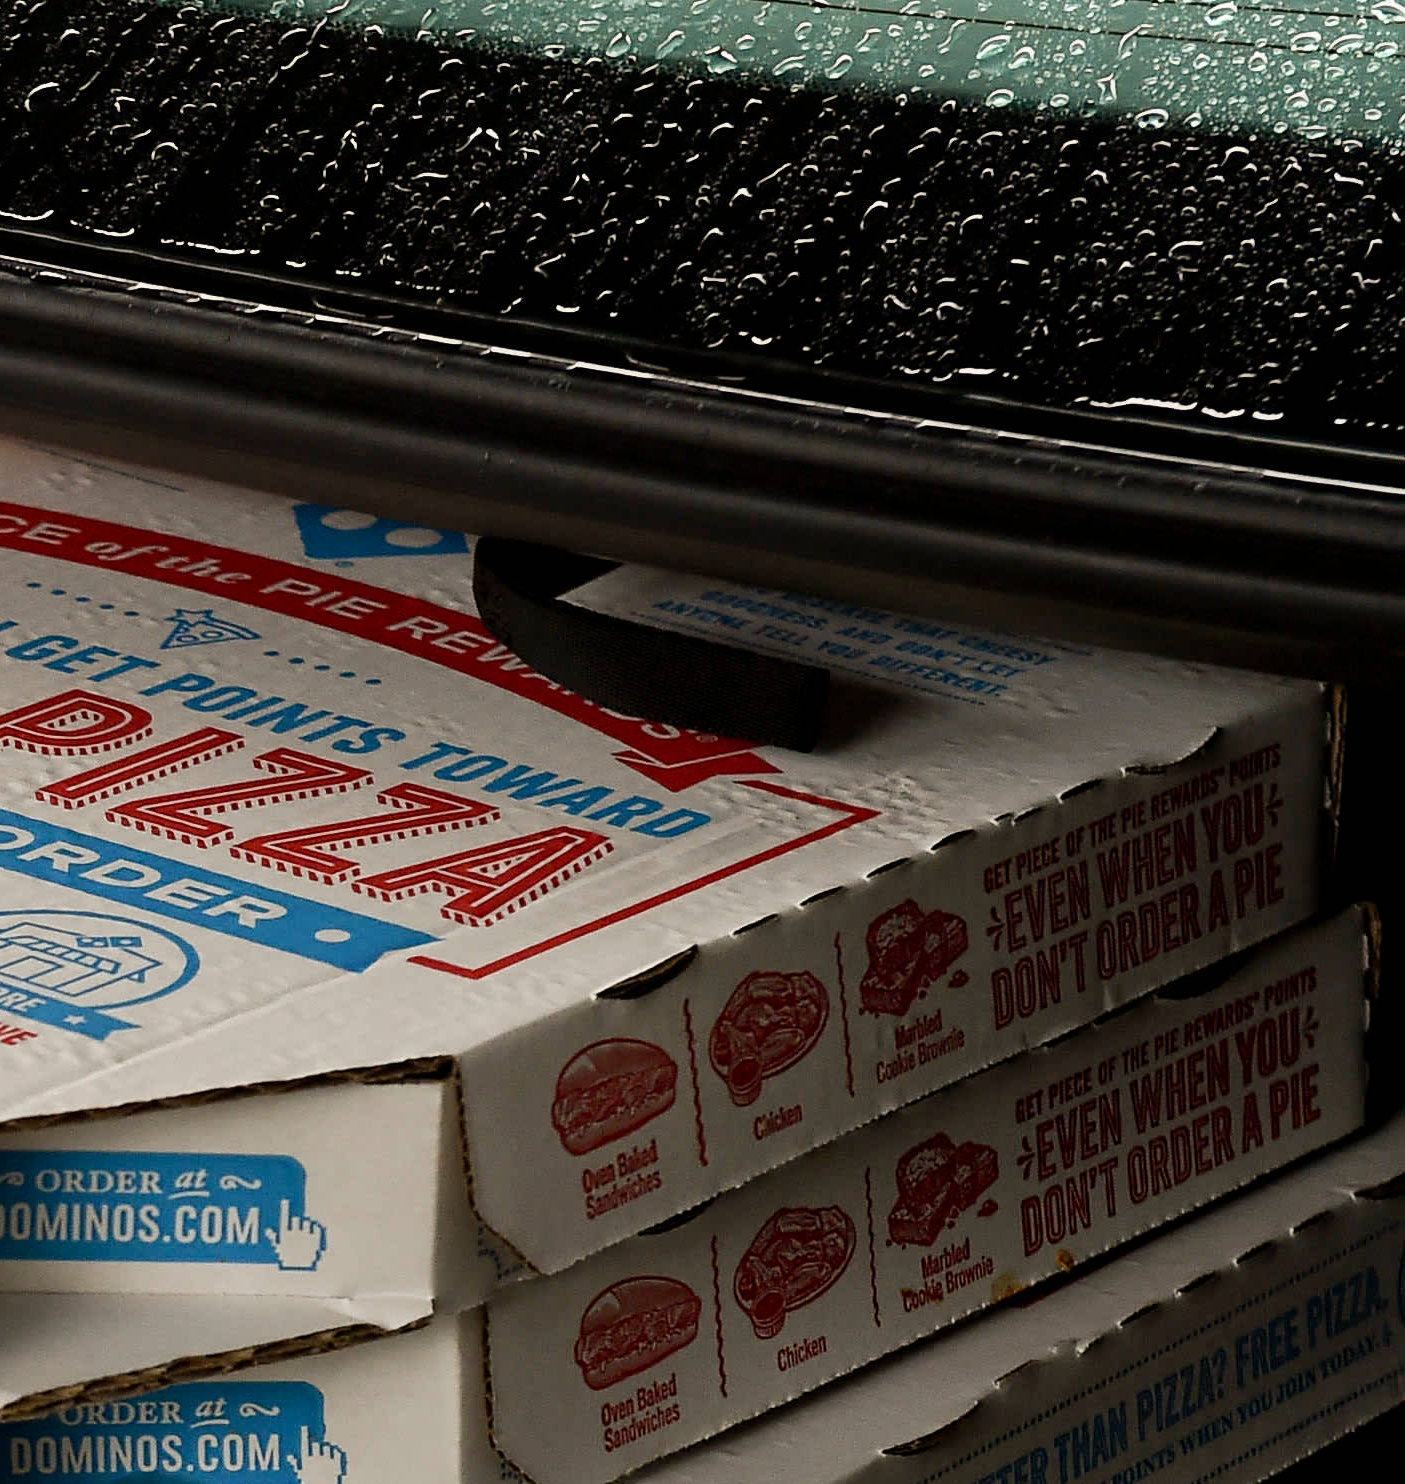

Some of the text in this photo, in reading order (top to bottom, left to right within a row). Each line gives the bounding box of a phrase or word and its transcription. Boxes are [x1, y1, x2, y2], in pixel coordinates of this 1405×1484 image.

[86, 535, 159, 575] of
[164, 545, 251, 584] the
[259, 575, 386, 622] PIE
[5, 635, 159, 681] GET
[142, 674, 406, 756] POINTS
[401, 742, 714, 839] TOWARD
[1021, 1064, 1321, 1257] DON'T ORDER A PIE
[1036, 1006, 1301, 1183] EVEN WHEN YOU
[36, 1169, 209, 1194] ORDER at
[777, 1336, 827, 1374] Chicken
